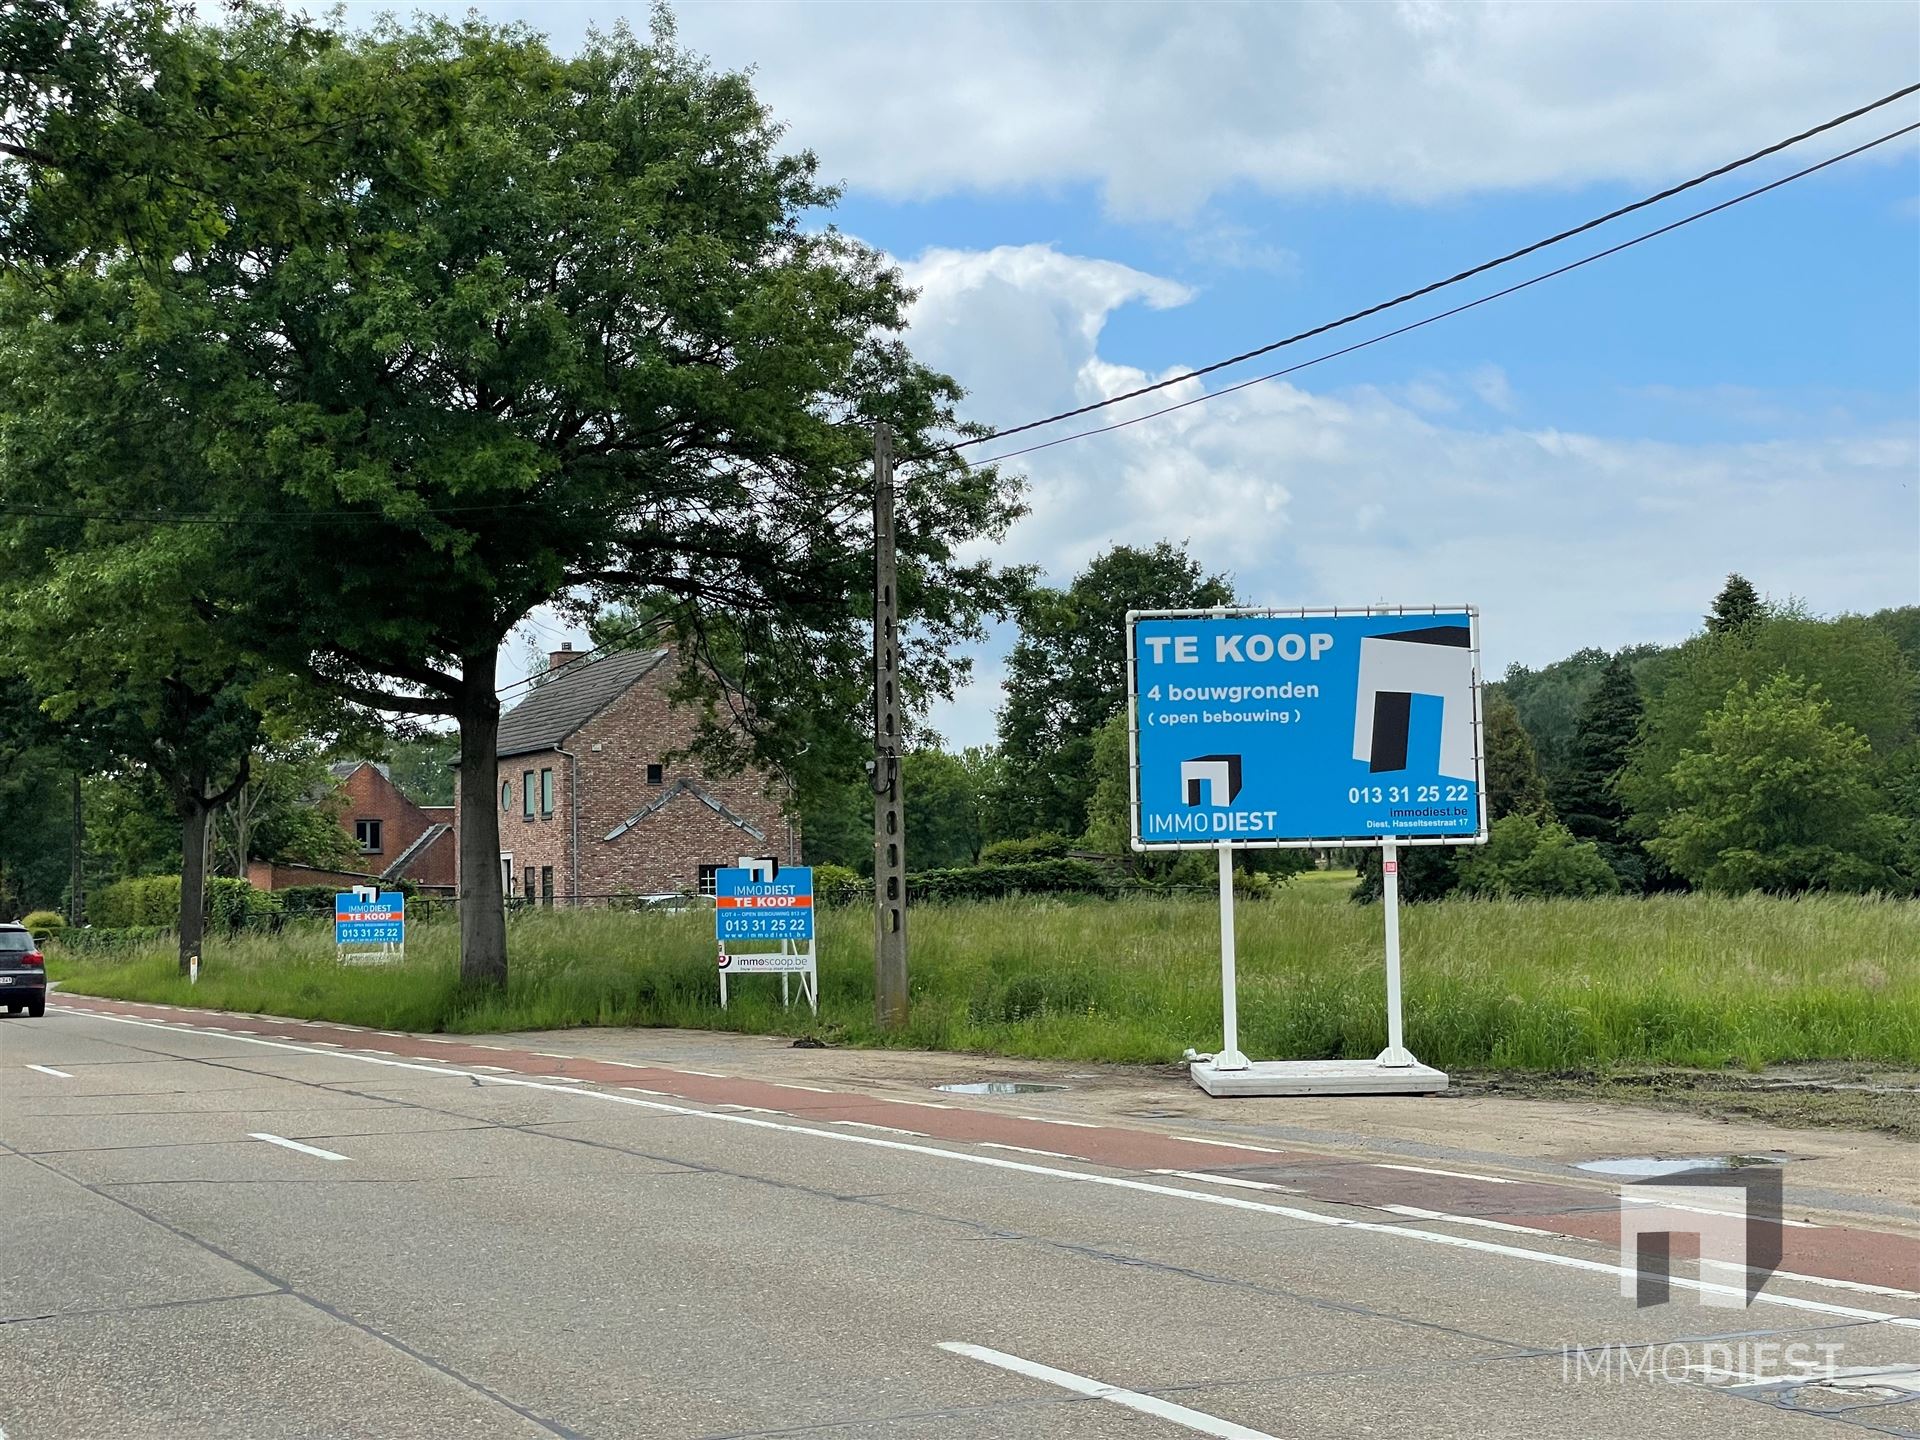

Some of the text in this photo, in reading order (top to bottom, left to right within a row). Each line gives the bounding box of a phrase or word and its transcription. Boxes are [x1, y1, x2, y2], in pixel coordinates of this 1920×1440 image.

[1145, 633, 1334, 664] TE KOOP
[1147, 681, 1319, 702] 4 bouwgronden
[1348, 784, 1468, 804] 013 31 25 22
[1390, 806, 1468, 817] immodiest.be
[1149, 811, 1278, 834] IMMO DIEST
[1392, 818, 1457, 828] Hasseltsestraat
[1459, 818, 1468, 826] 17
[734, 884, 796, 896] IMMO DIEST
[734, 897, 796, 907] TE KOOP
[364, 912, 392, 920] KOOP
[725, 919, 805, 931] 013 31 25 22
[342, 928, 398, 937] 013 31 25 22
[737, 956, 808, 967] immoscoop.be
